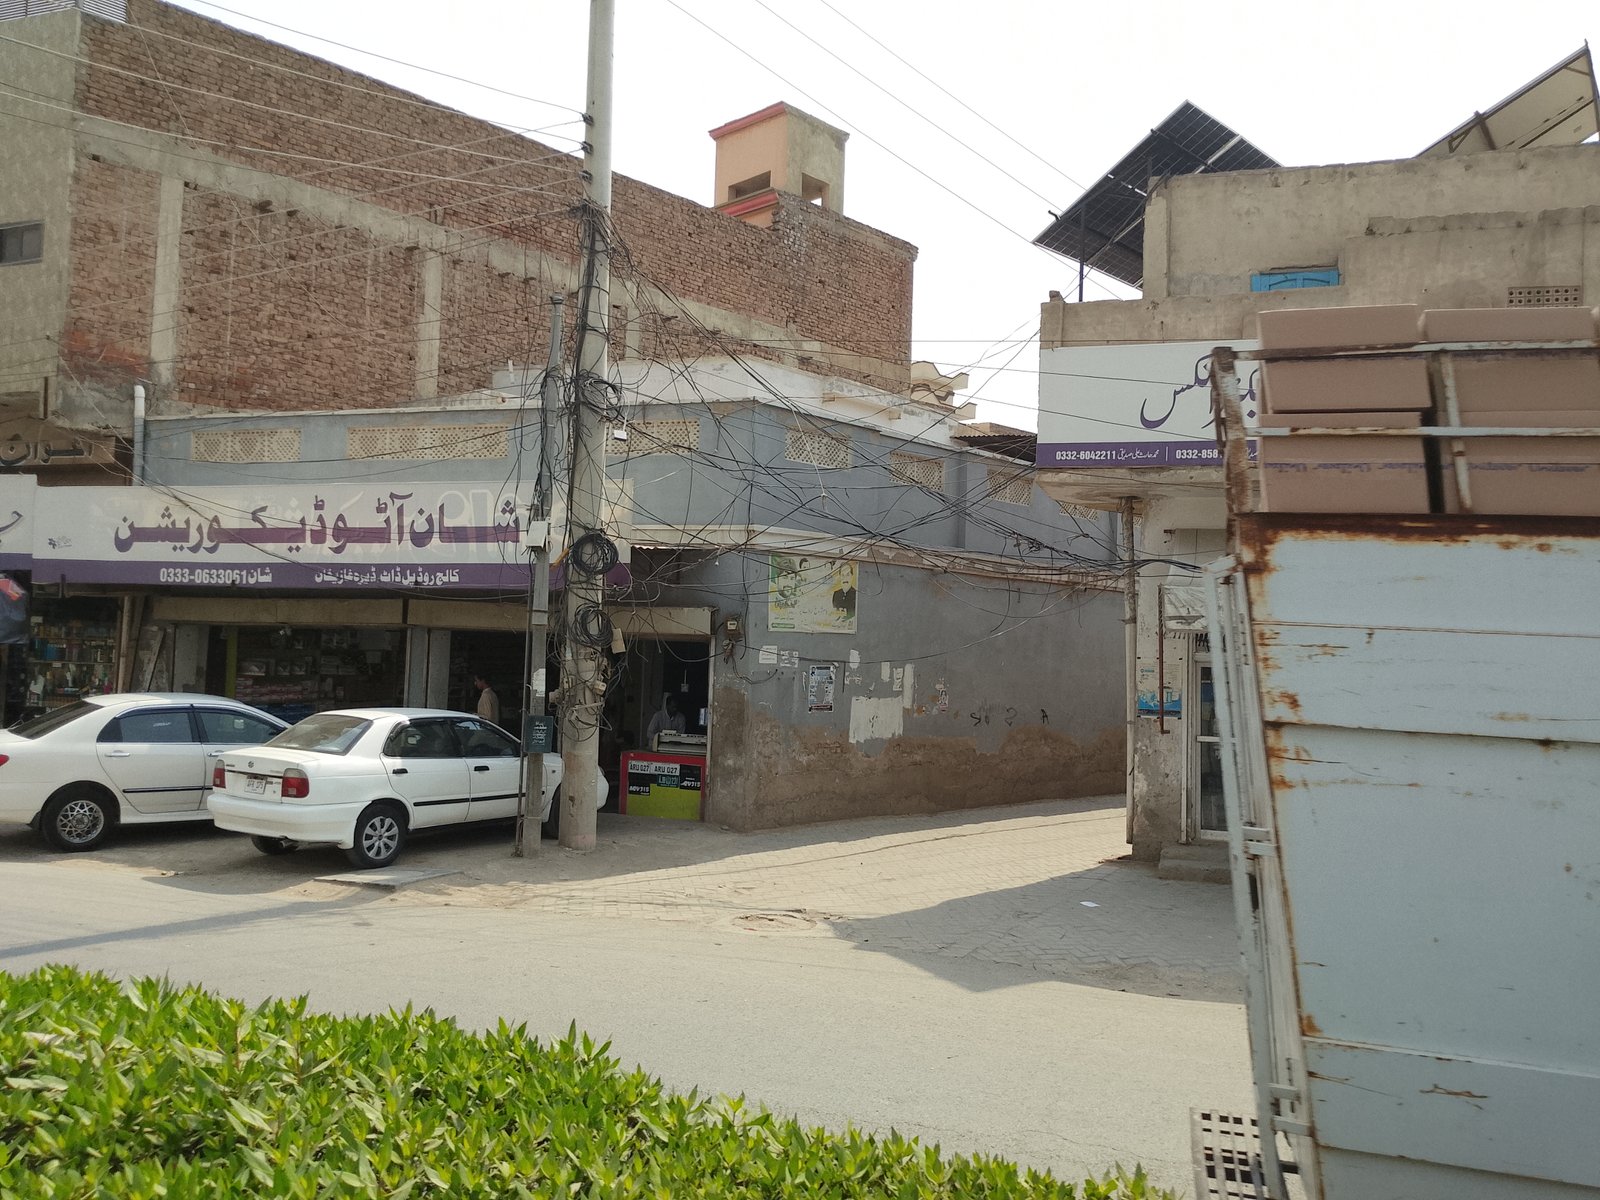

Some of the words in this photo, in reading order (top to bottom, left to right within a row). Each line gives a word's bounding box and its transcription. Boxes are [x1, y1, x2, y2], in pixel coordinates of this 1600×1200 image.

[1055, 449, 1116, 461] 0332-6042211
[113, 495, 327, 554] ڈیکوریشن
[328, 491, 413, 554] آٹو
[409, 499, 520, 548] شان
[159, 567, 247, 585] 0333-0633061
[247, 567, 273, 585] شان
[417, 566, 435, 586] روڈ
[435, 569, 460, 586] کالج
